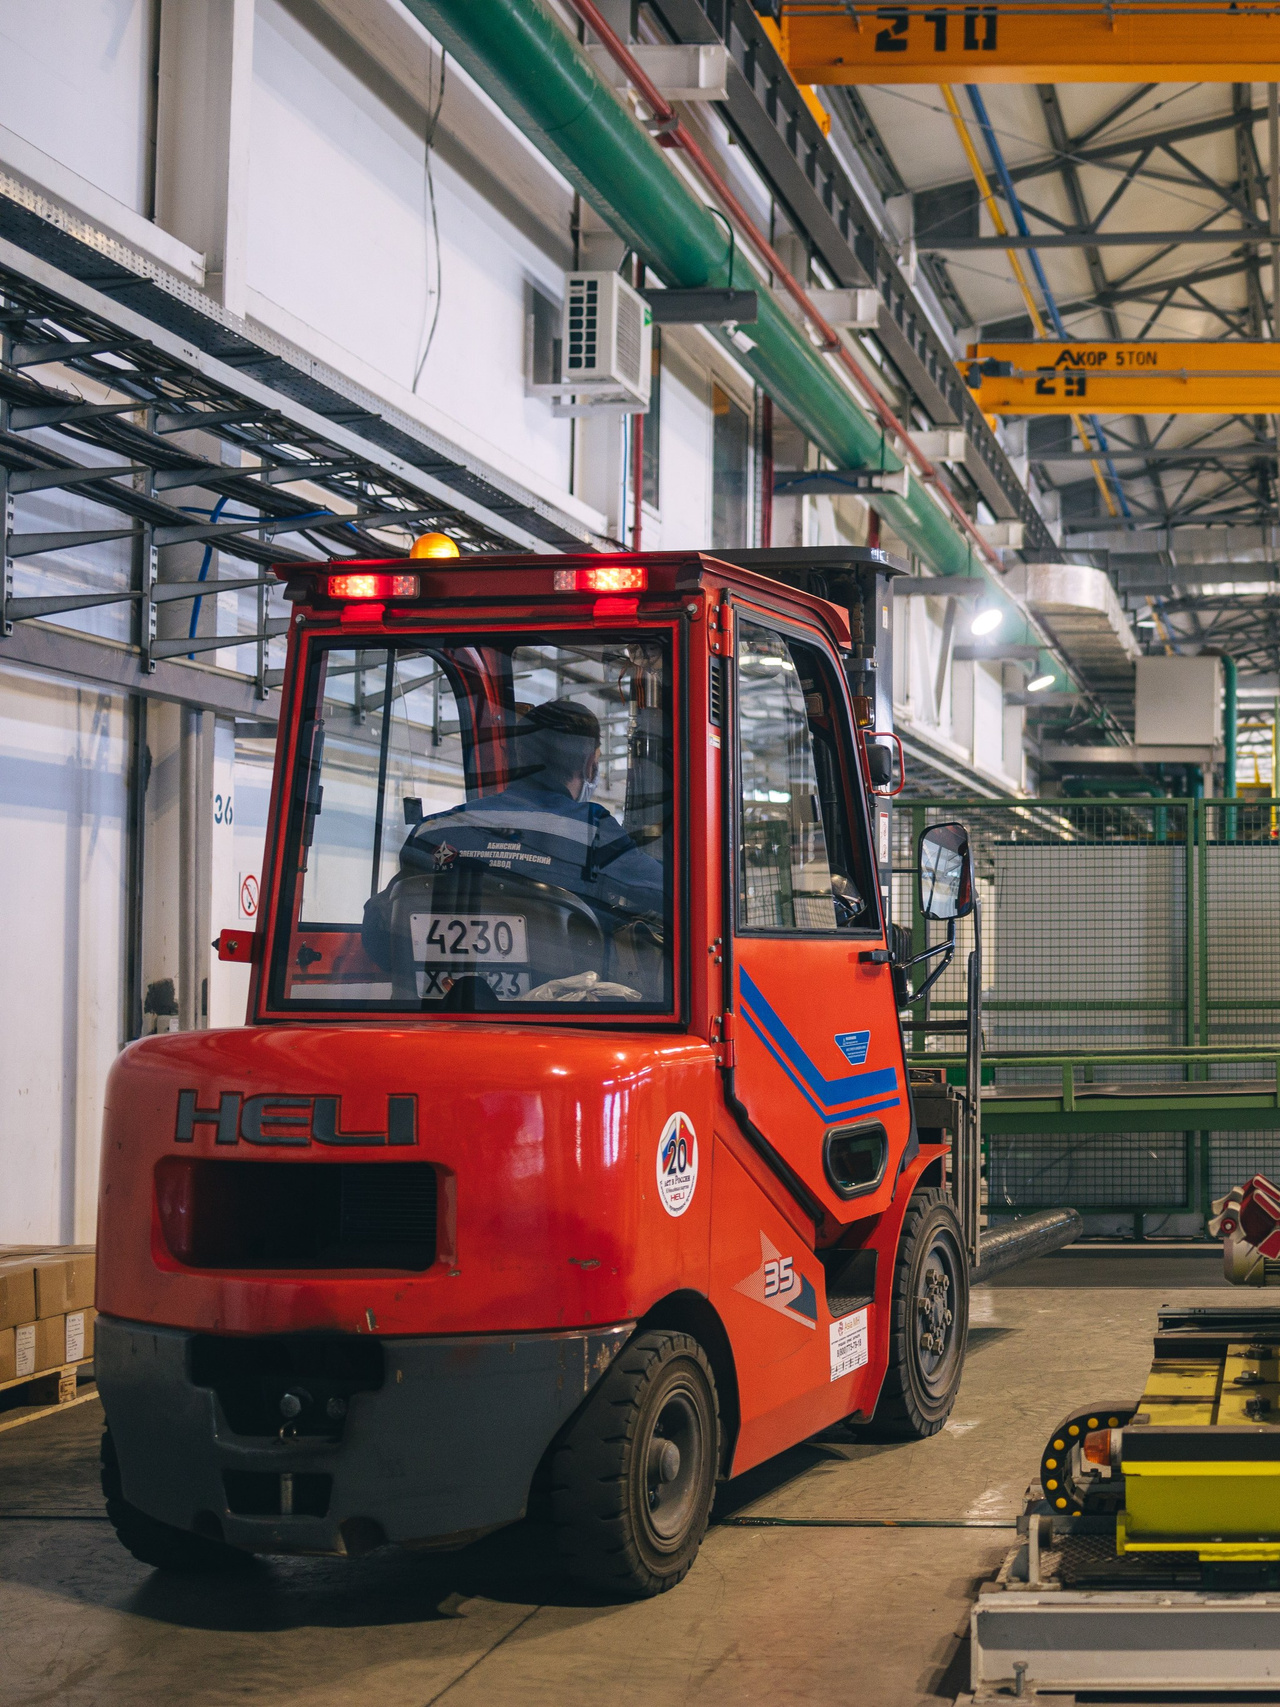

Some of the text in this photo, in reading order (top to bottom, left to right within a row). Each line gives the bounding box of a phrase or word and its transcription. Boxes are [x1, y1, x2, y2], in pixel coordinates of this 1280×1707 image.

[875, 7, 997, 51] 210
[214, 794, 233, 825] 36
[459, 850, 551, 865] ЭЛЕКТРОМЕТАЛЛУРГИЧЕСКИЙ
[487, 842, 521, 851] АБИНСКИЙ
[489, 859, 511, 869] ЗАВОД
[426, 919, 514, 955] 4230
[488, 971, 520, 996] 23
[175, 1089, 419, 1147] HELI
[667, 1138, 687, 1176] 20
[670, 1191, 685, 1202] HELI
[764, 1255, 794, 1298] 35
